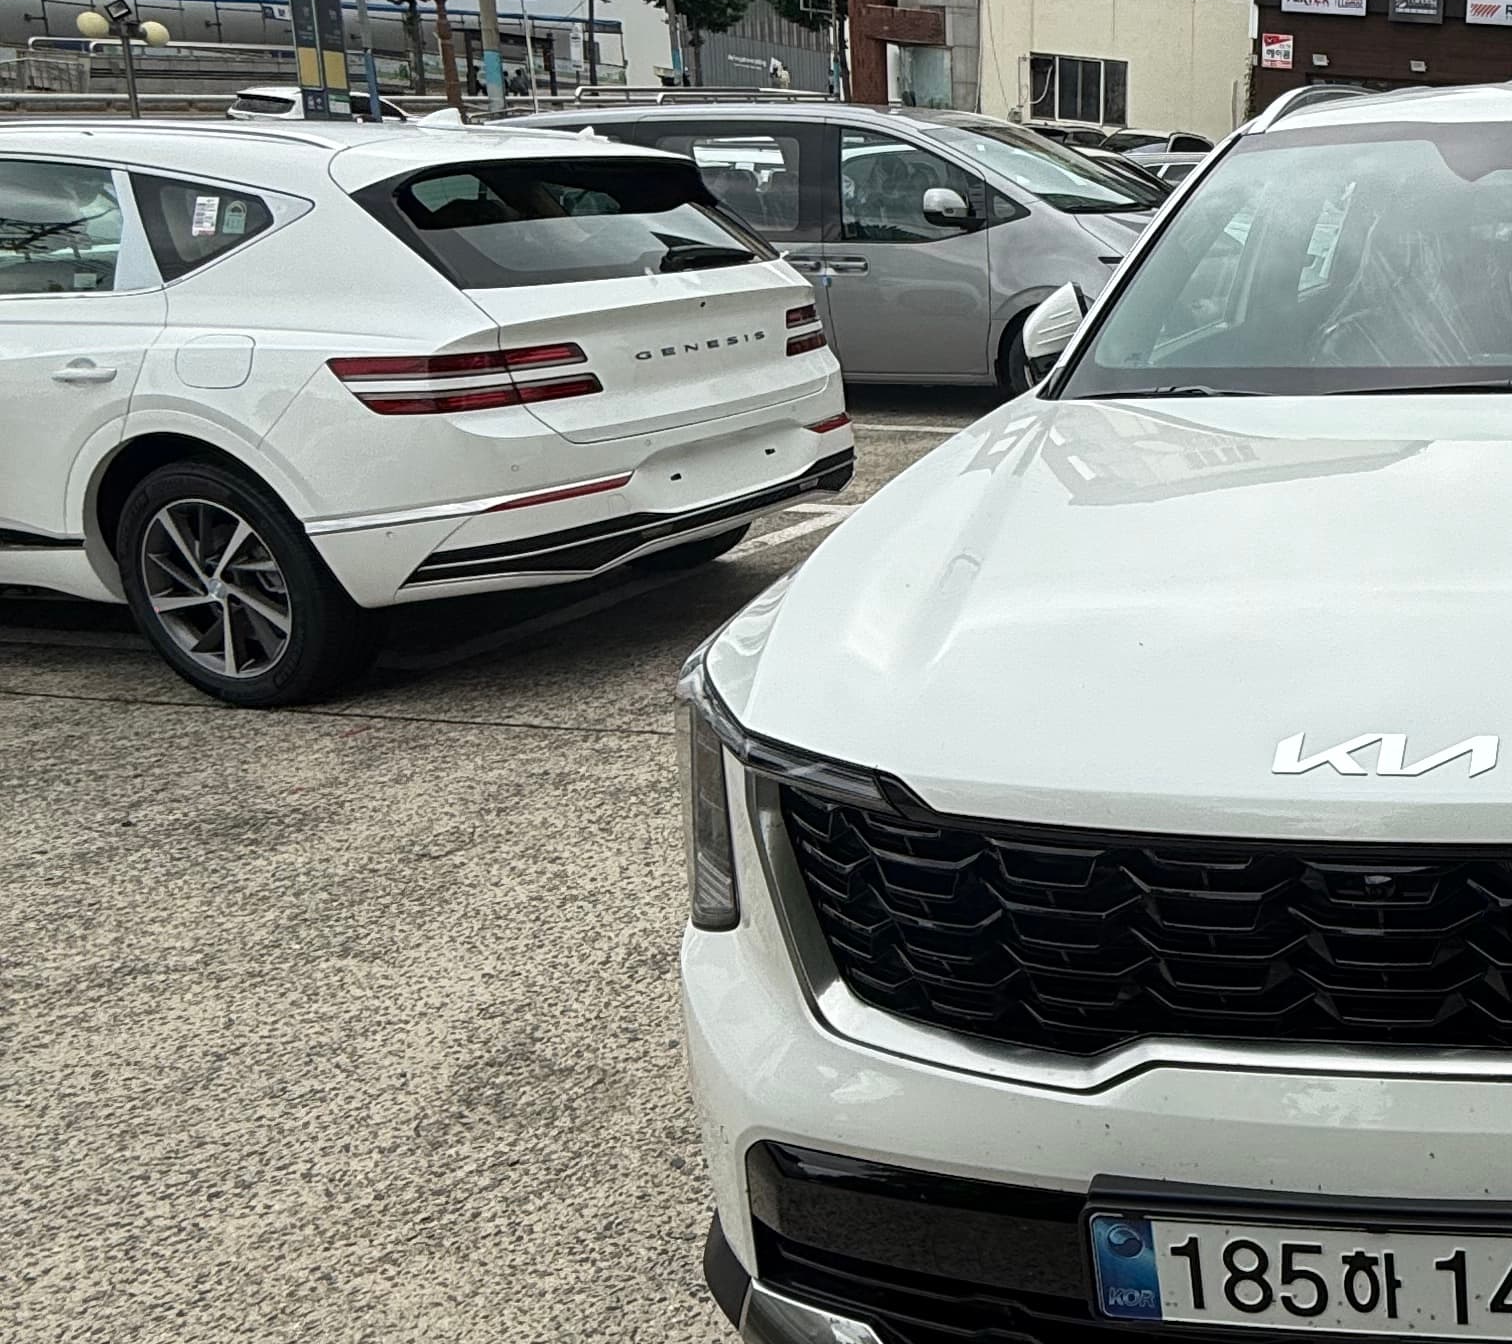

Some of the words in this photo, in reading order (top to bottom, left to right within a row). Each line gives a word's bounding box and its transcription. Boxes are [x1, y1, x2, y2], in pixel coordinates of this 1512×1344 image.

[634, 330, 766, 361] GENESIS
[1271, 731, 1500, 779] KIA
[1169, 1234, 1402, 1319] 185하
[1107, 1286, 1157, 1309] KOR
